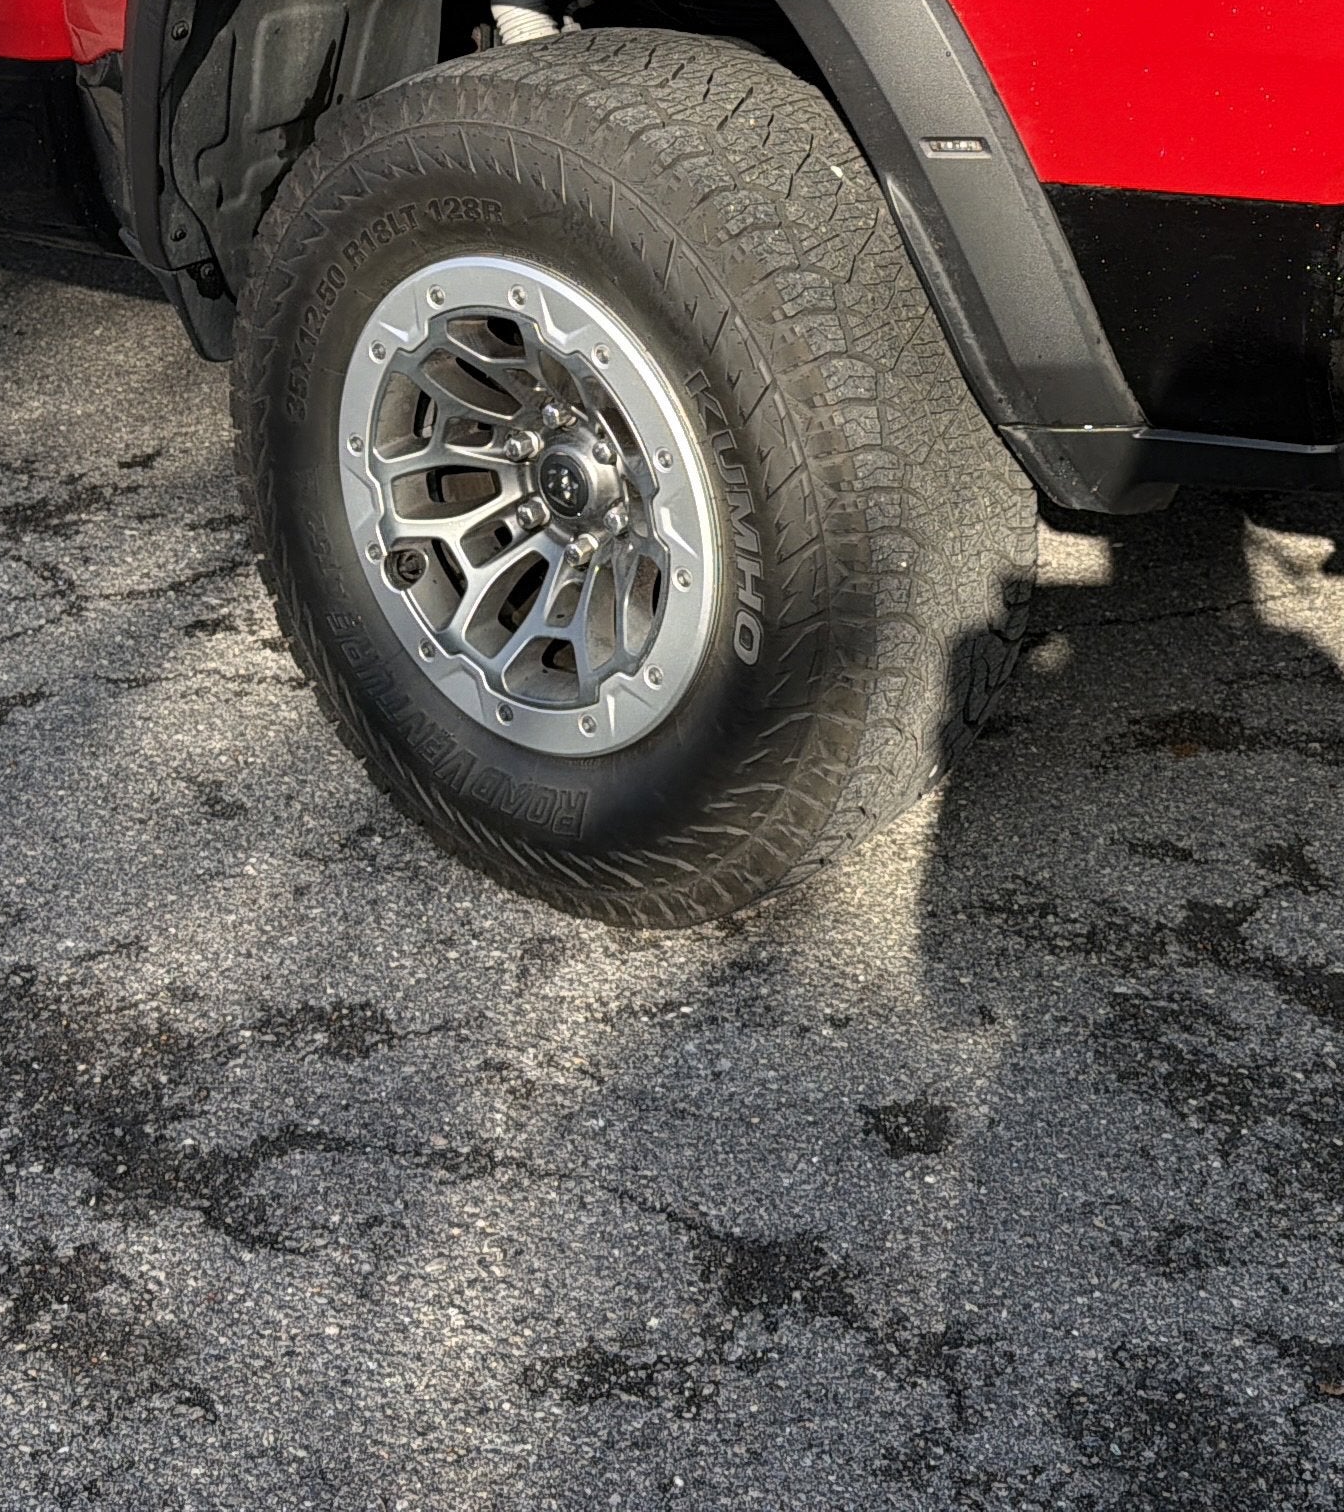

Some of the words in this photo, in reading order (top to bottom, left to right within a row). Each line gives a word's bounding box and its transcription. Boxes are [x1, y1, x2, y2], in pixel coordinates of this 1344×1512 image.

[341, 203, 421, 272] R18LT
[426, 195, 505, 225] 128R
[684, 368, 766, 666] KUMHO
